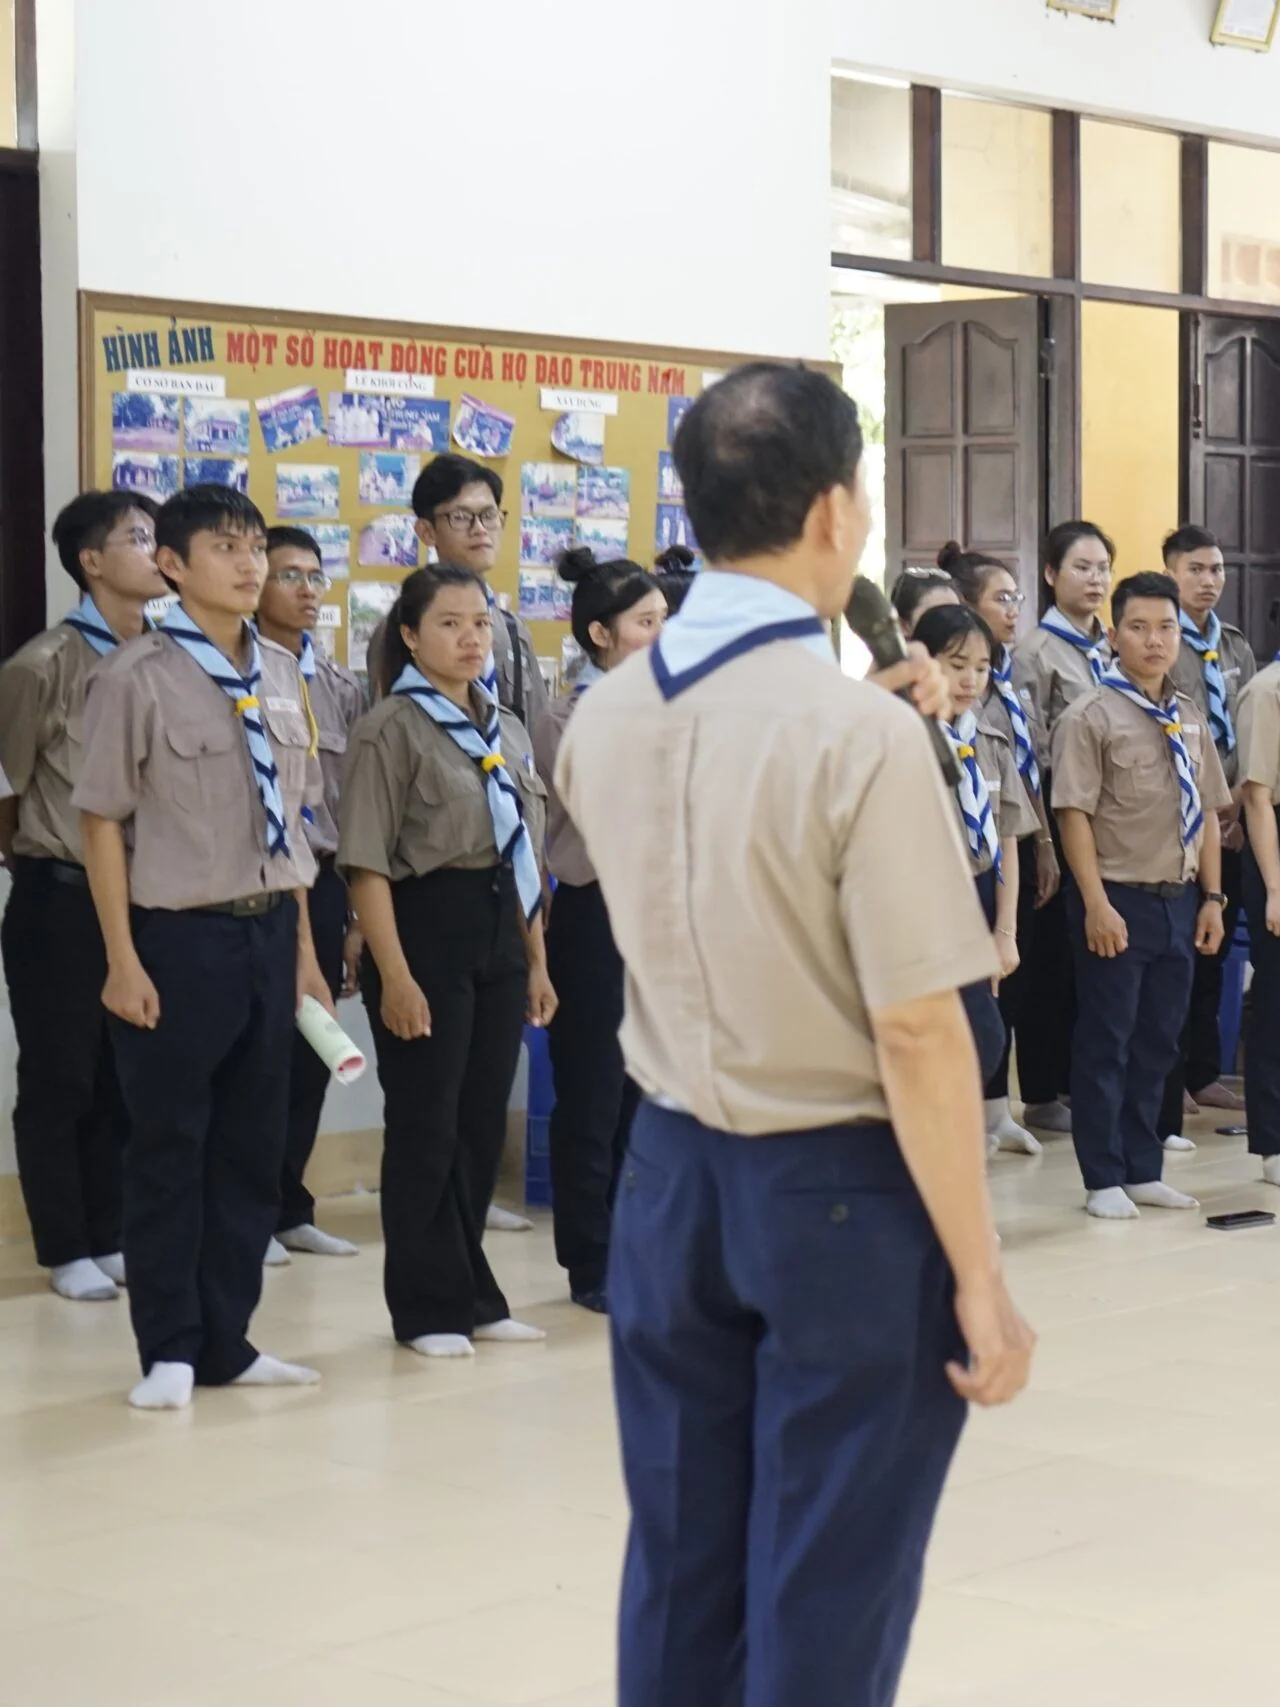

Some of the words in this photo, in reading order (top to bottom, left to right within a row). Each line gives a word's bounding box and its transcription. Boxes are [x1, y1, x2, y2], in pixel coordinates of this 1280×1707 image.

[102, 325, 161, 373] HÌNH
[168, 316, 215, 366] ẢNH
[226, 325, 278, 373] MỘT
[285, 328, 315, 367] SỐ
[502, 352, 527, 389] HỌ
[580, 359, 642, 393] TRUNG
[648, 364, 686, 396] NAM
